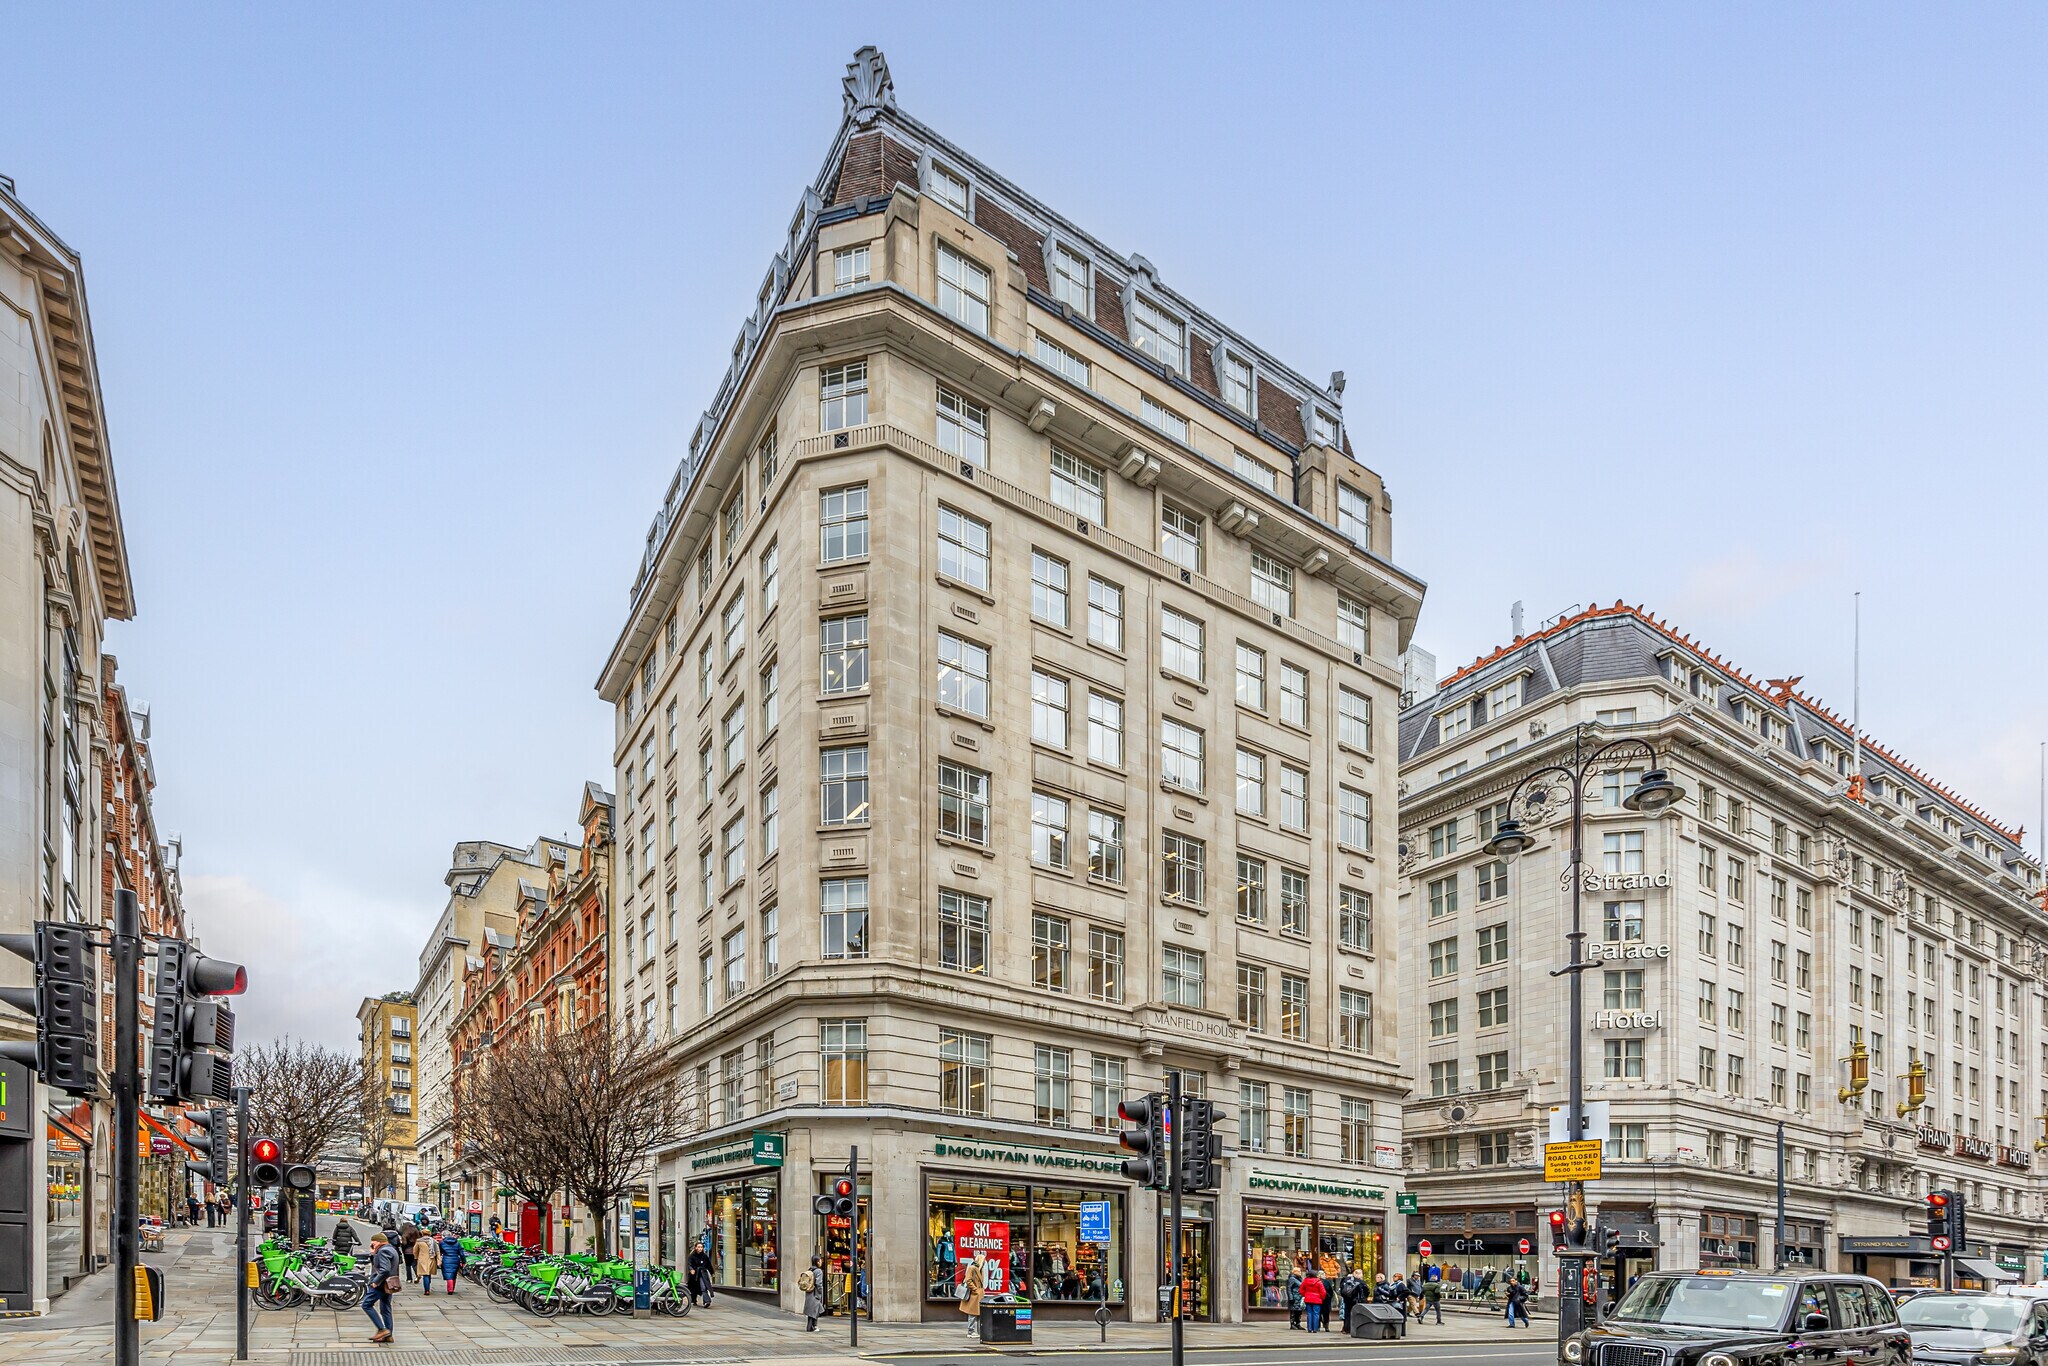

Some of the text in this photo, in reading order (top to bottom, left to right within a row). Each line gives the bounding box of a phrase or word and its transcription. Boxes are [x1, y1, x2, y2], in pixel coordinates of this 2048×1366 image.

[1585, 868, 1671, 892] Strand
[1588, 942, 1671, 960] Palace
[1154, 1013, 1239, 1040] MANFIELD HOUSE
[1596, 1010, 1662, 1029] Hotel
[1917, 1126, 2032, 1166] STRAND PALACE HOTEL
[948, 1145, 1122, 1173] MOUNTAIN WAREHOUSE
[1257, 1177, 1386, 1200] MOUNTAIN WAREHOUSE
[830, 1216, 850, 1226] SAL
[973, 1222, 990, 1236] SKI
[960, 1236, 1004, 1250] CLEARANCE
[988, 1279, 1003, 1291] OFF
